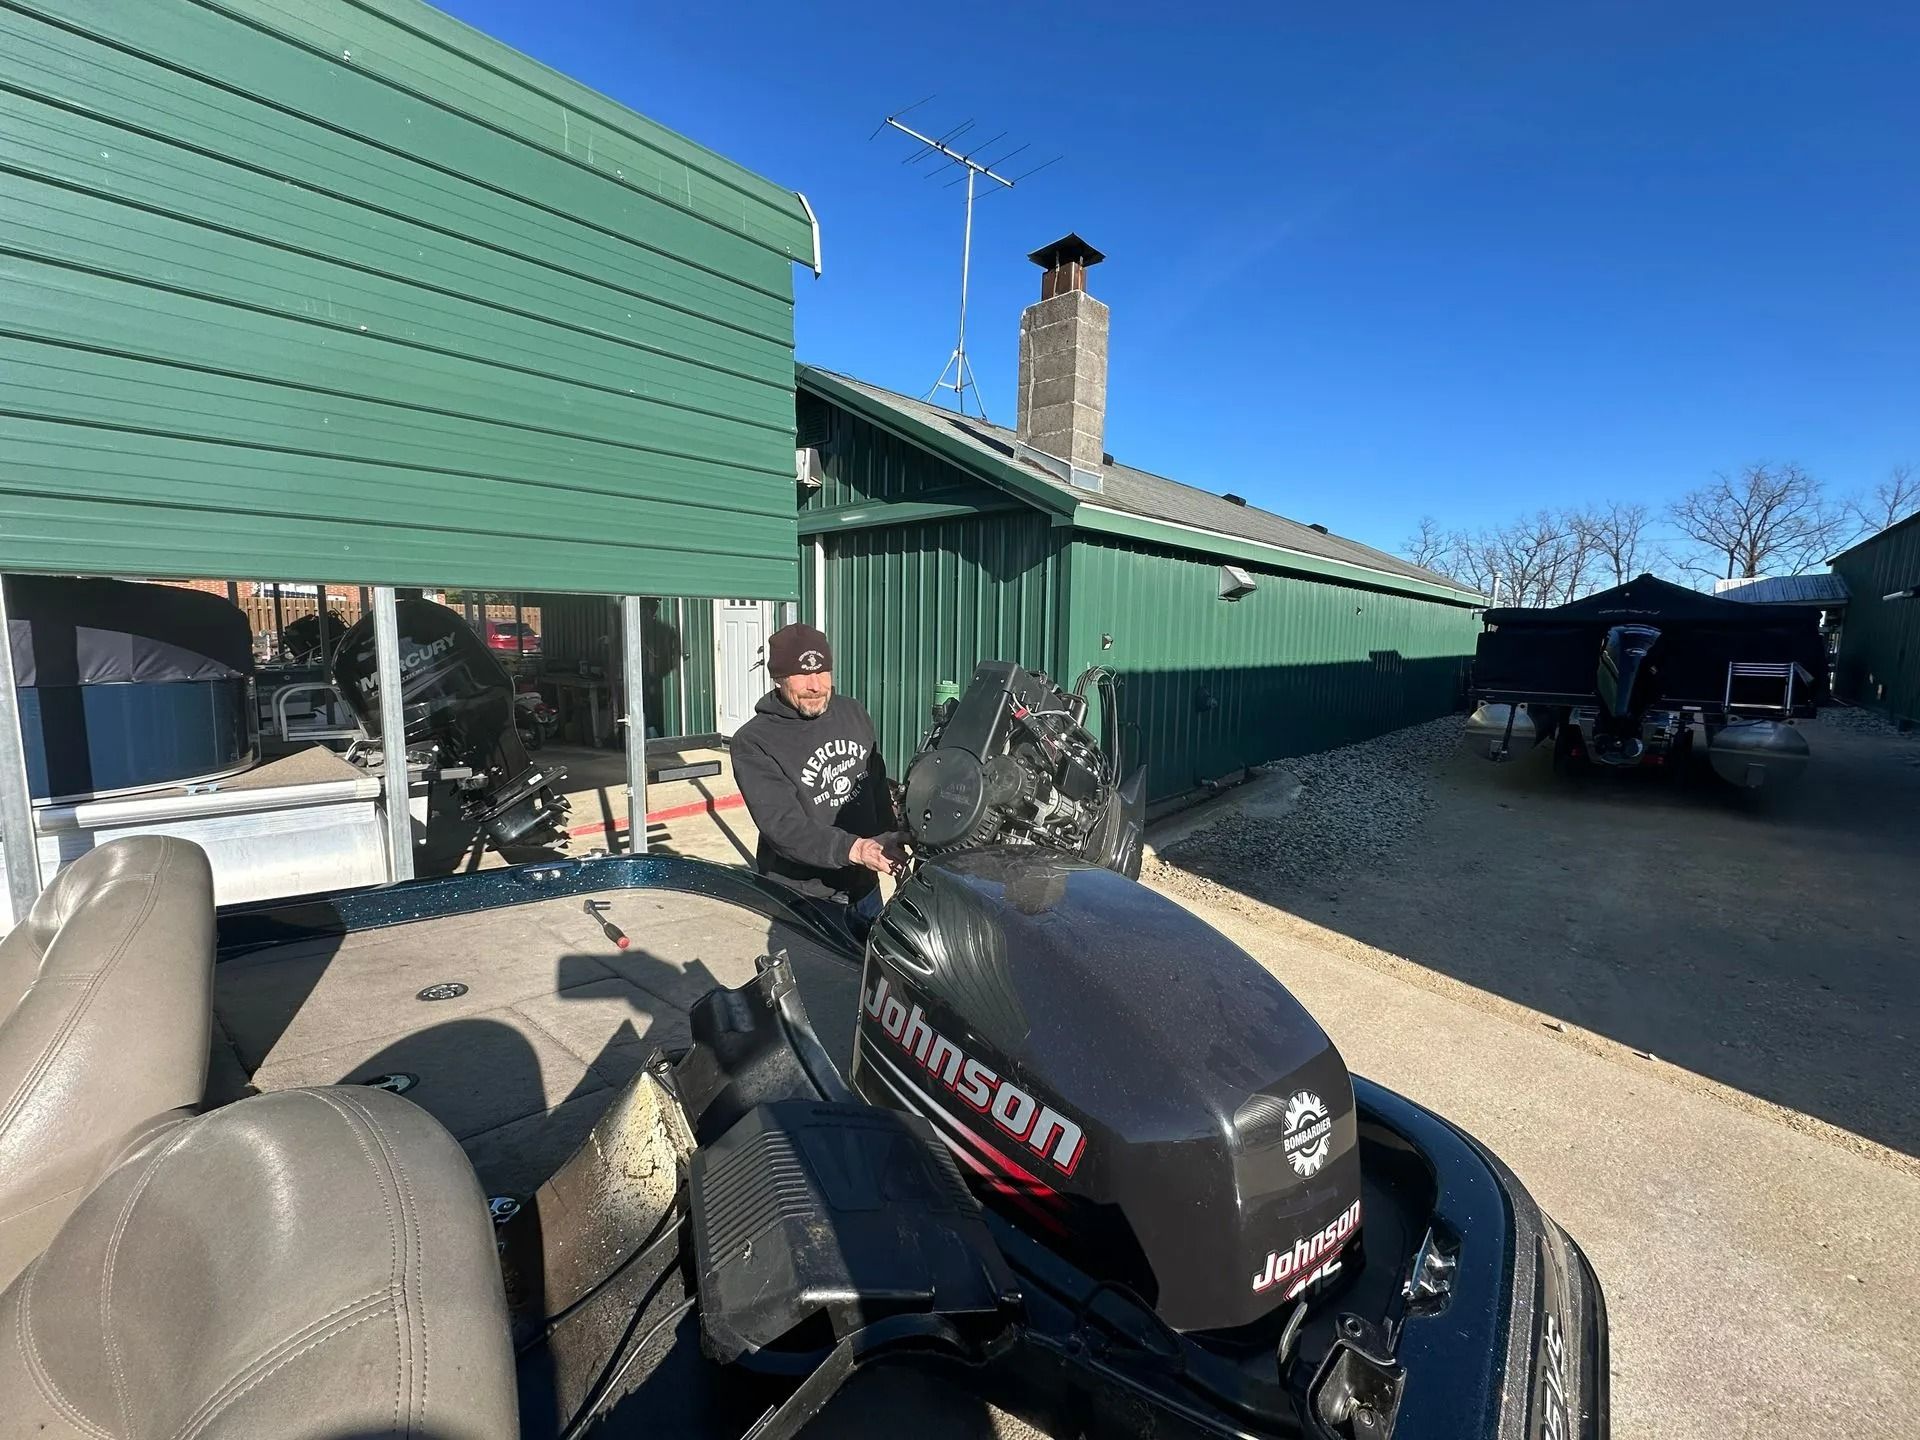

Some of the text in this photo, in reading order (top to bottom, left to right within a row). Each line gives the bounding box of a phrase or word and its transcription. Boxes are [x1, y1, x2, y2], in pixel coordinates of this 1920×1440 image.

[360, 631, 456, 692] MRCURY
[801, 739, 867, 788] MERCURY
[820, 757, 856, 789] Marine
[863, 976, 1088, 1178] Johnson
[1284, 1116, 1332, 1152] BOMBARDIER
[1252, 1199, 1361, 1292] Johnson
